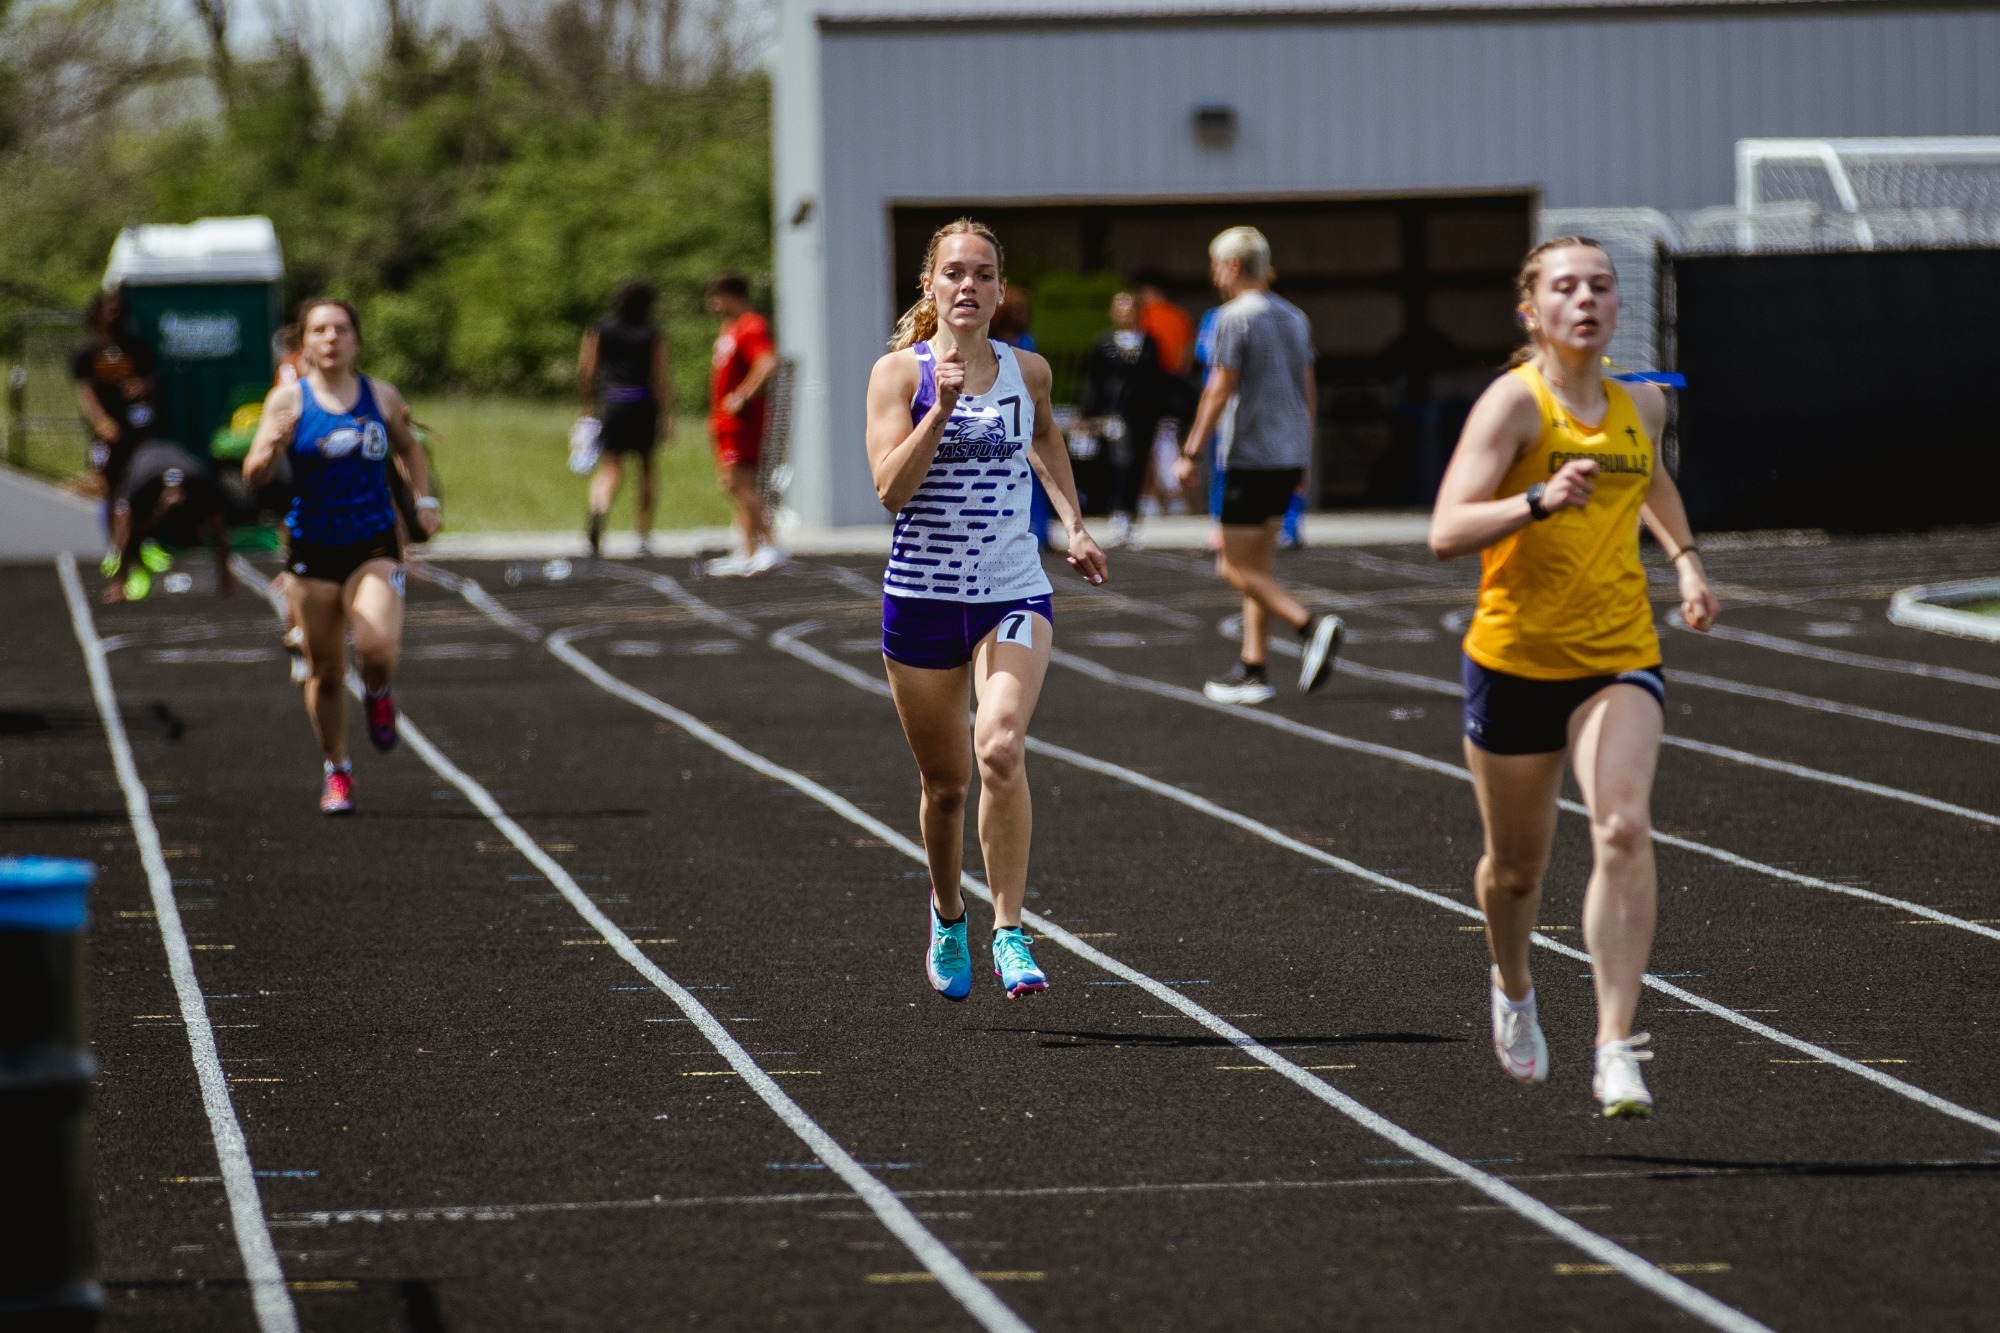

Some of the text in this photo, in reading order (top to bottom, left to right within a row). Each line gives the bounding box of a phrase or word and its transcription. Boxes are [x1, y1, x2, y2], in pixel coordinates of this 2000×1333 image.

[998, 395, 1021, 438] 7
[938, 442, 1021, 460] ASBURY
[1001, 613, 1026, 640] 7
